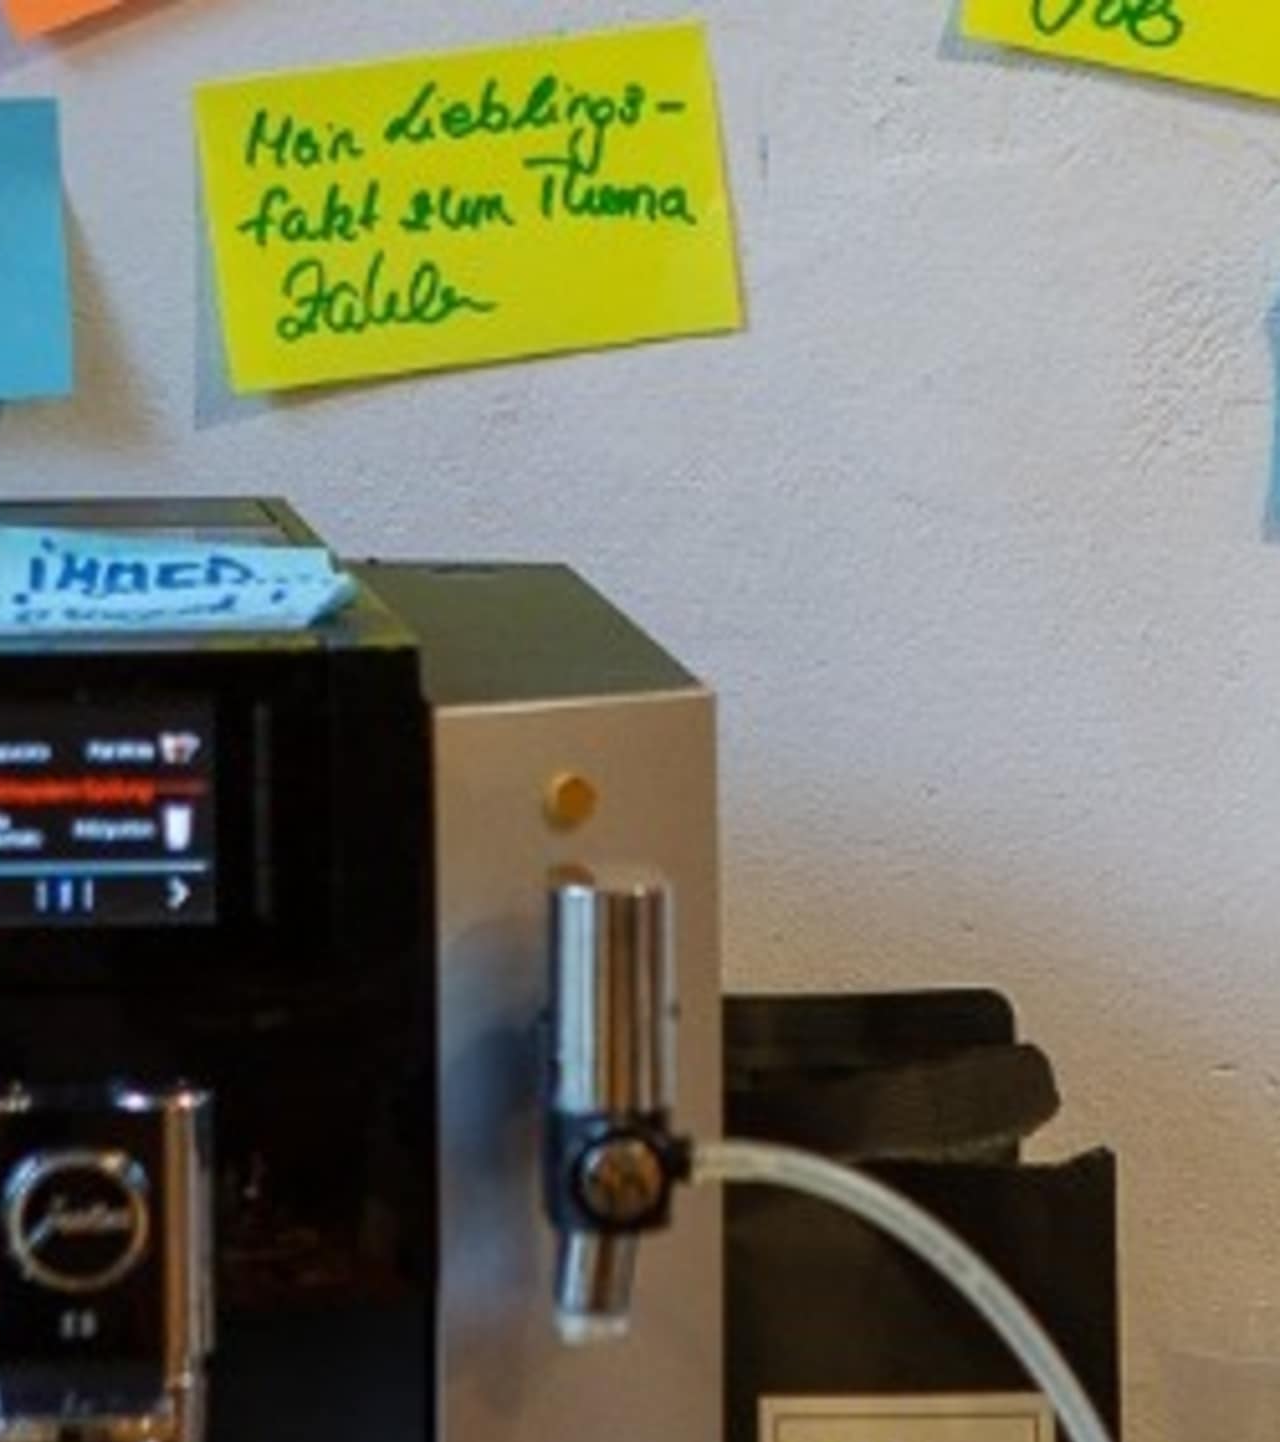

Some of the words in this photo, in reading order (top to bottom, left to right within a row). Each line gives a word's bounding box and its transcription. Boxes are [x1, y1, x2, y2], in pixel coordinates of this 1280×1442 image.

[245, 106, 363, 166] Mein
[400, 182, 516, 234] zum
[276, 250, 498, 342] Zahlen
